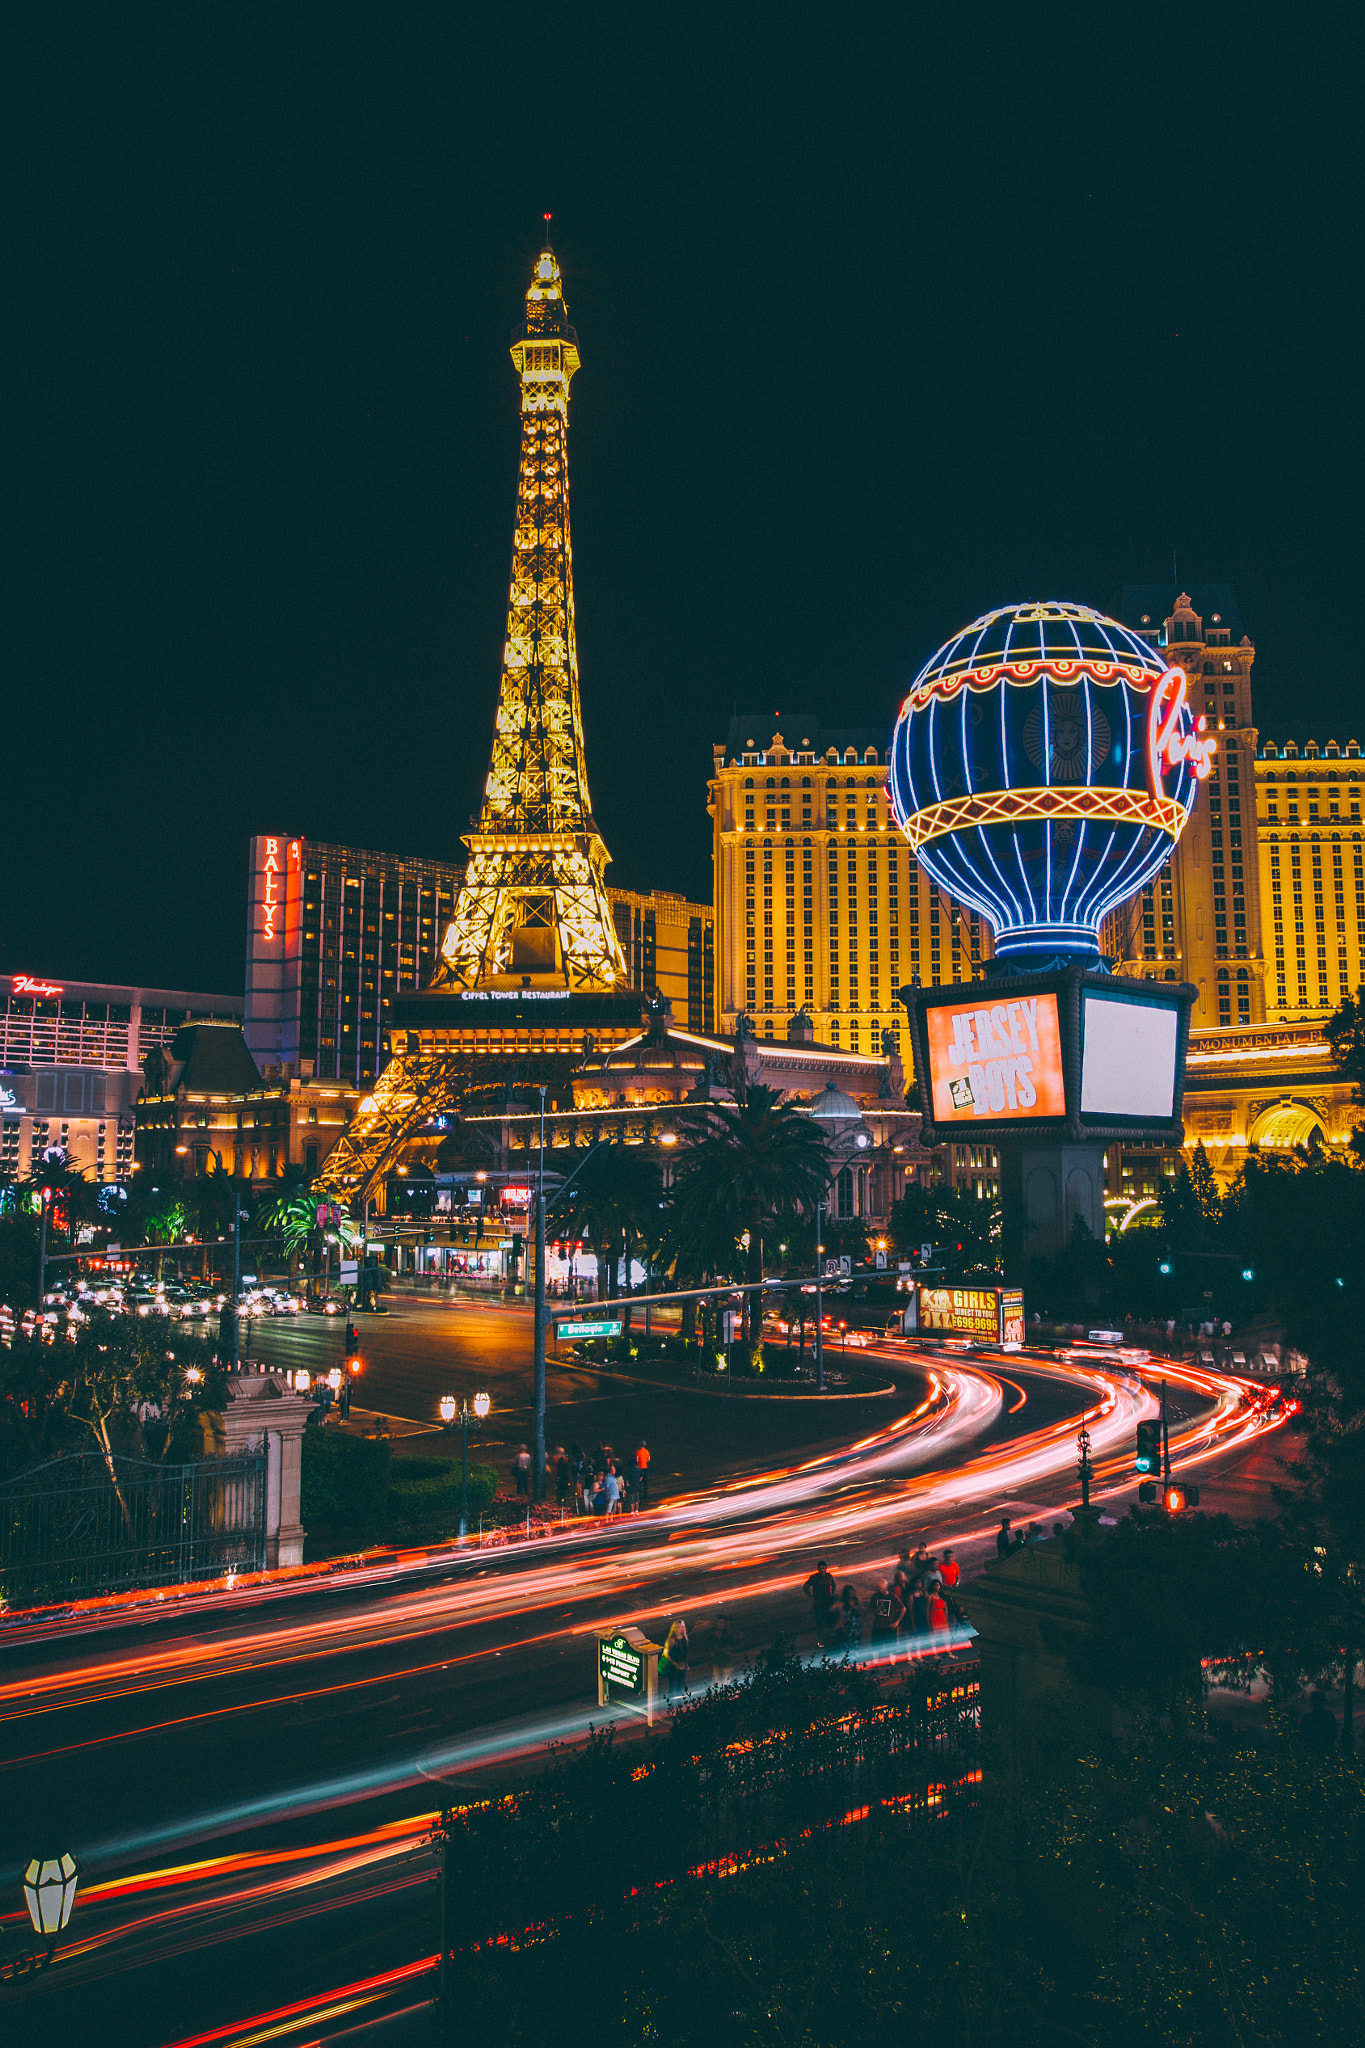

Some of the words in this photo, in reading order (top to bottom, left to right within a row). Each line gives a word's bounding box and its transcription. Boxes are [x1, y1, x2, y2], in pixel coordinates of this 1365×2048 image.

[1150, 666, 1217, 800] Paris
[461, 991, 489, 1000] EIFFEL
[490, 990, 519, 999] TOWER
[521, 990, 571, 999] RESTAURANT
[948, 998, 1039, 1066] JERSEY
[1199, 1032, 1300, 1050] MONUMENTAL
[968, 1055, 1037, 1115] BOYS
[953, 1290, 996, 1310] GIRLS
[954, 1307, 974, 1316] DIRECT
[975, 1309, 982, 1317] TO
[982, 1310, 995, 1318] YOU!
[567, 1324, 603, 1335] Bellagio
[957, 1315, 998, 1331] 696-9696
